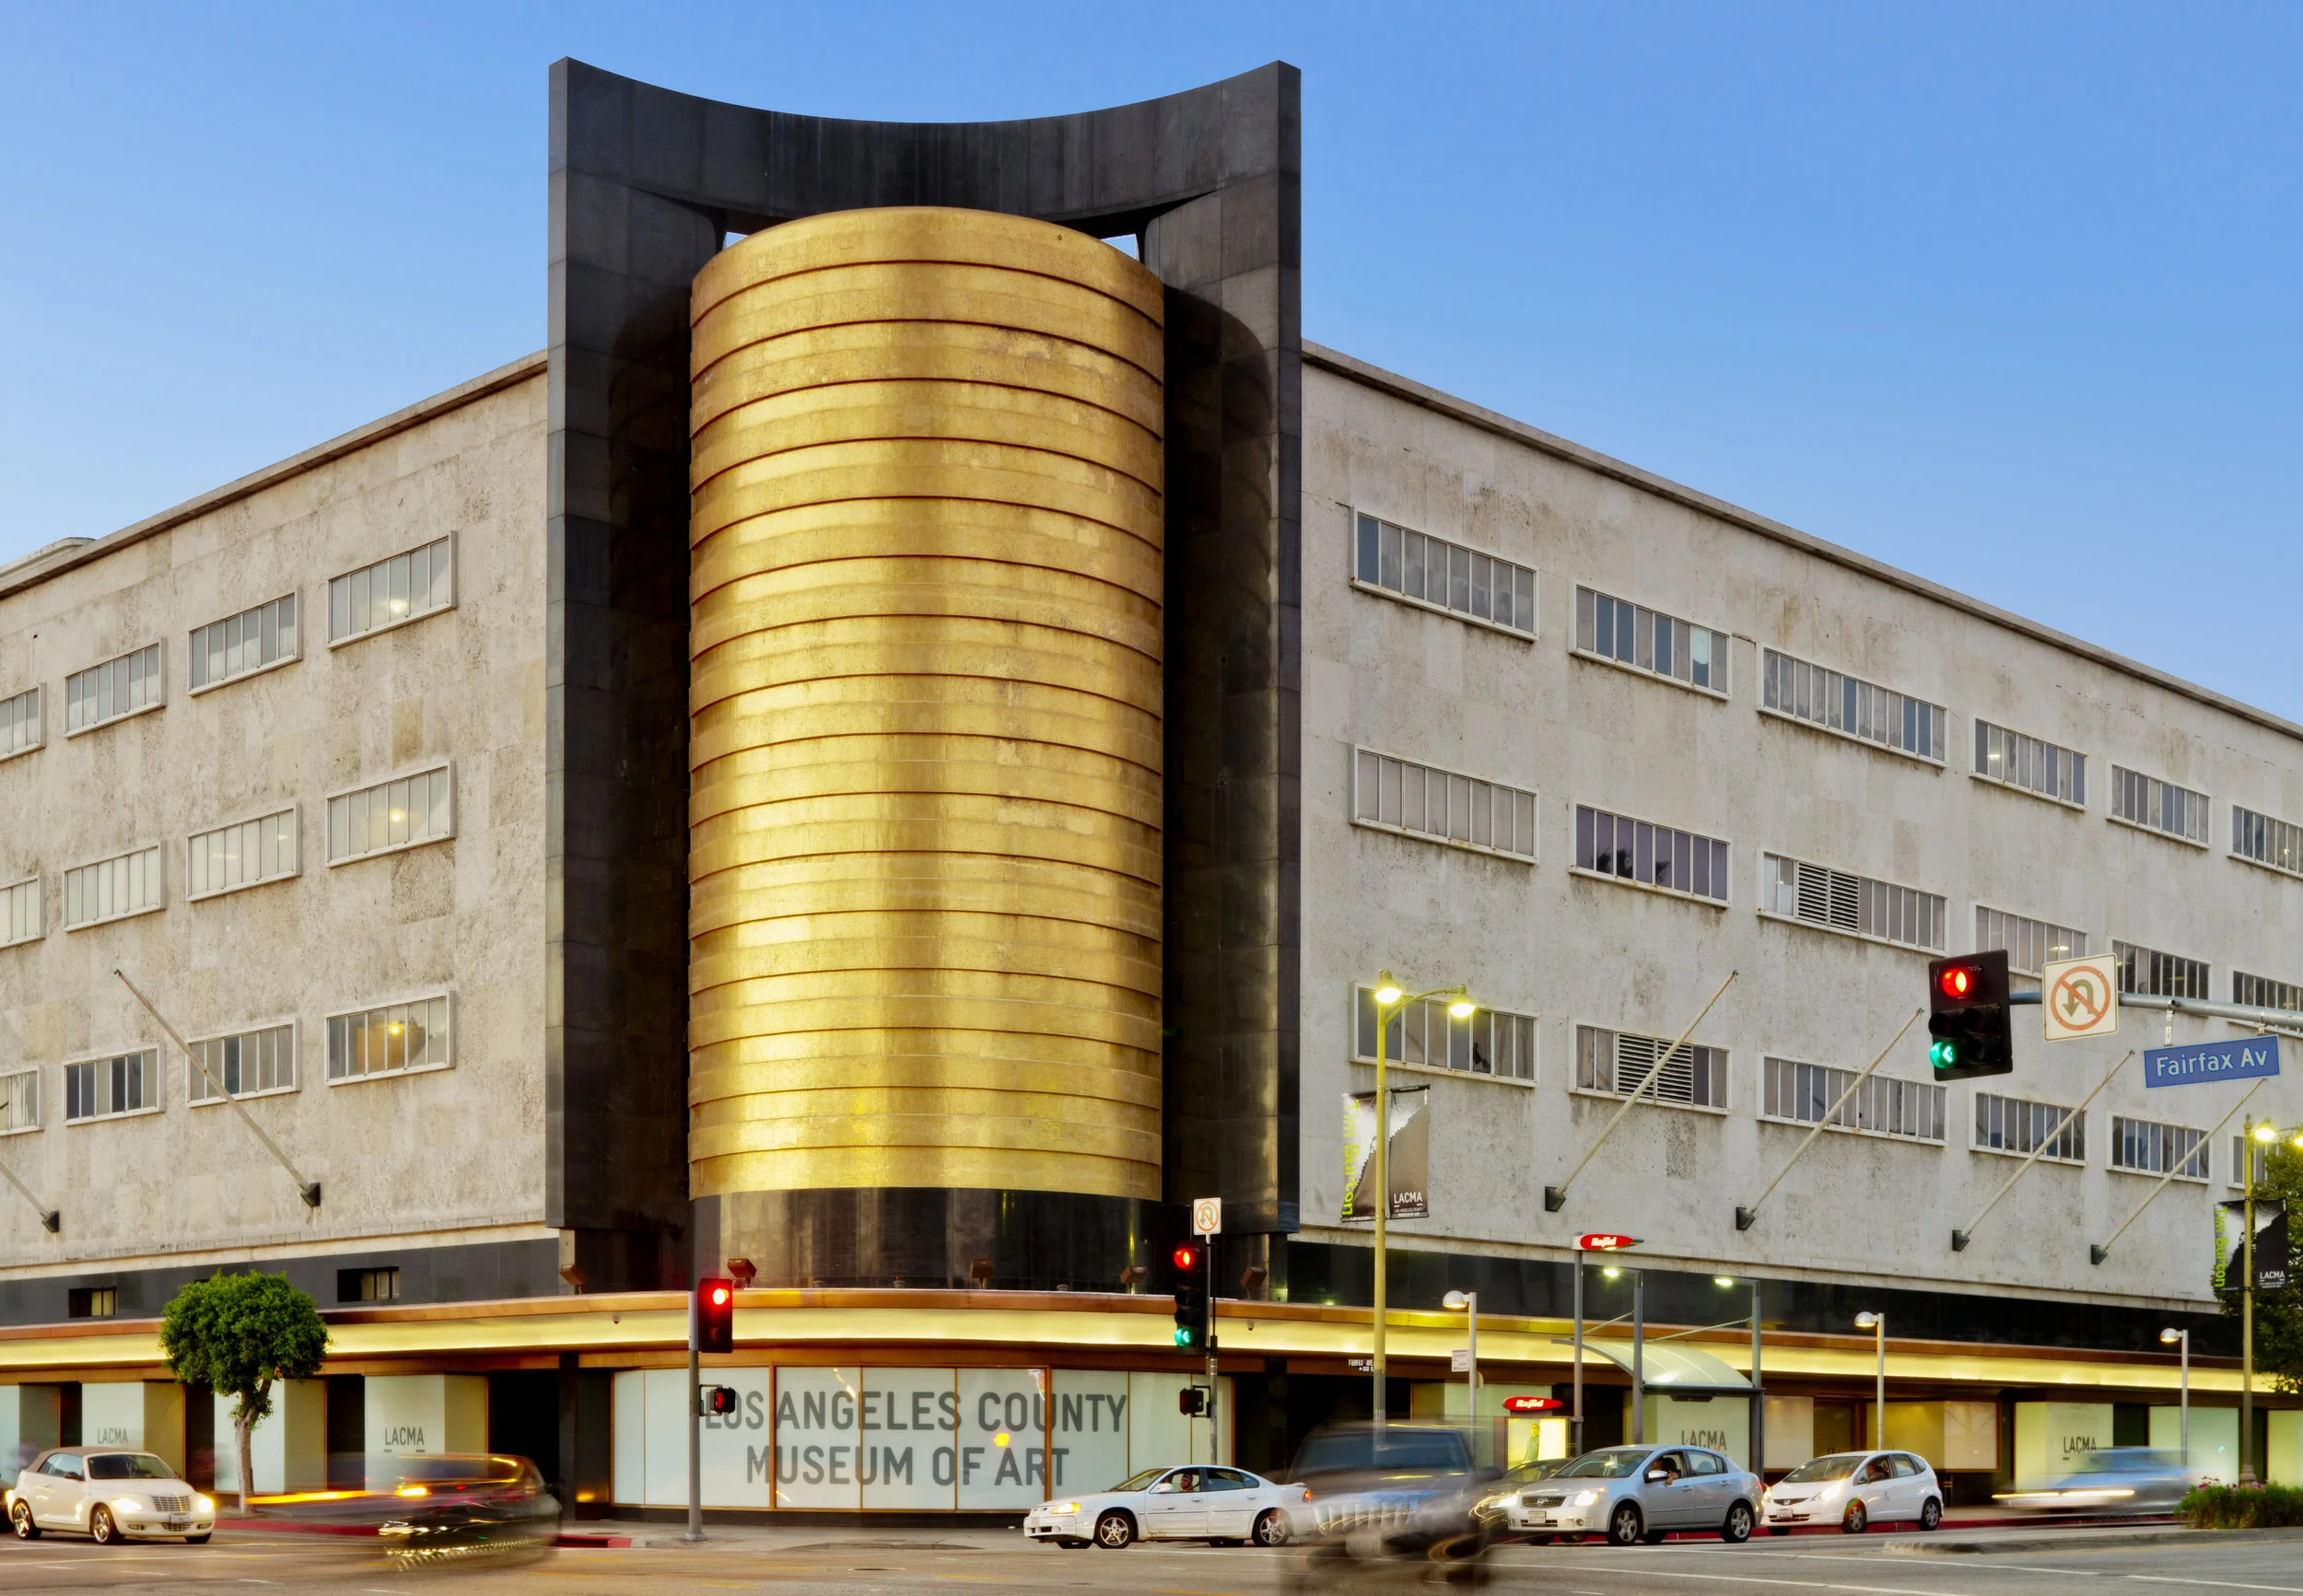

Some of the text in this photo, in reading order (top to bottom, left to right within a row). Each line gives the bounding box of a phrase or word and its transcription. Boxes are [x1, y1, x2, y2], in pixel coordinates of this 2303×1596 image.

[2156, 1047, 2267, 1077] Fairfax Av
[1342, 1100, 1361, 1137] Tim
[1341, 1145, 1361, 1216] Burton
[1393, 1192, 1423, 1204] LACMA
[1591, 1237, 1617, 1248] Rapid
[2214, 1206, 2228, 1287] Tim Burton
[2260, 1271, 2285, 1279] LACMA
[777, 1391, 962, 1431] ANGELES
[978, 1392, 1127, 1432] COUNTY
[1515, 1399, 1544, 1409] Rapid
[97, 1427, 128, 1445] LACMA
[384, 1427, 425, 1446] LACMA
[1681, 1429, 1727, 1450] LACMA
[2063, 1436, 2097, 1453] LACMA
[747, 1445, 1070, 1486] MUSEUM OF ART
